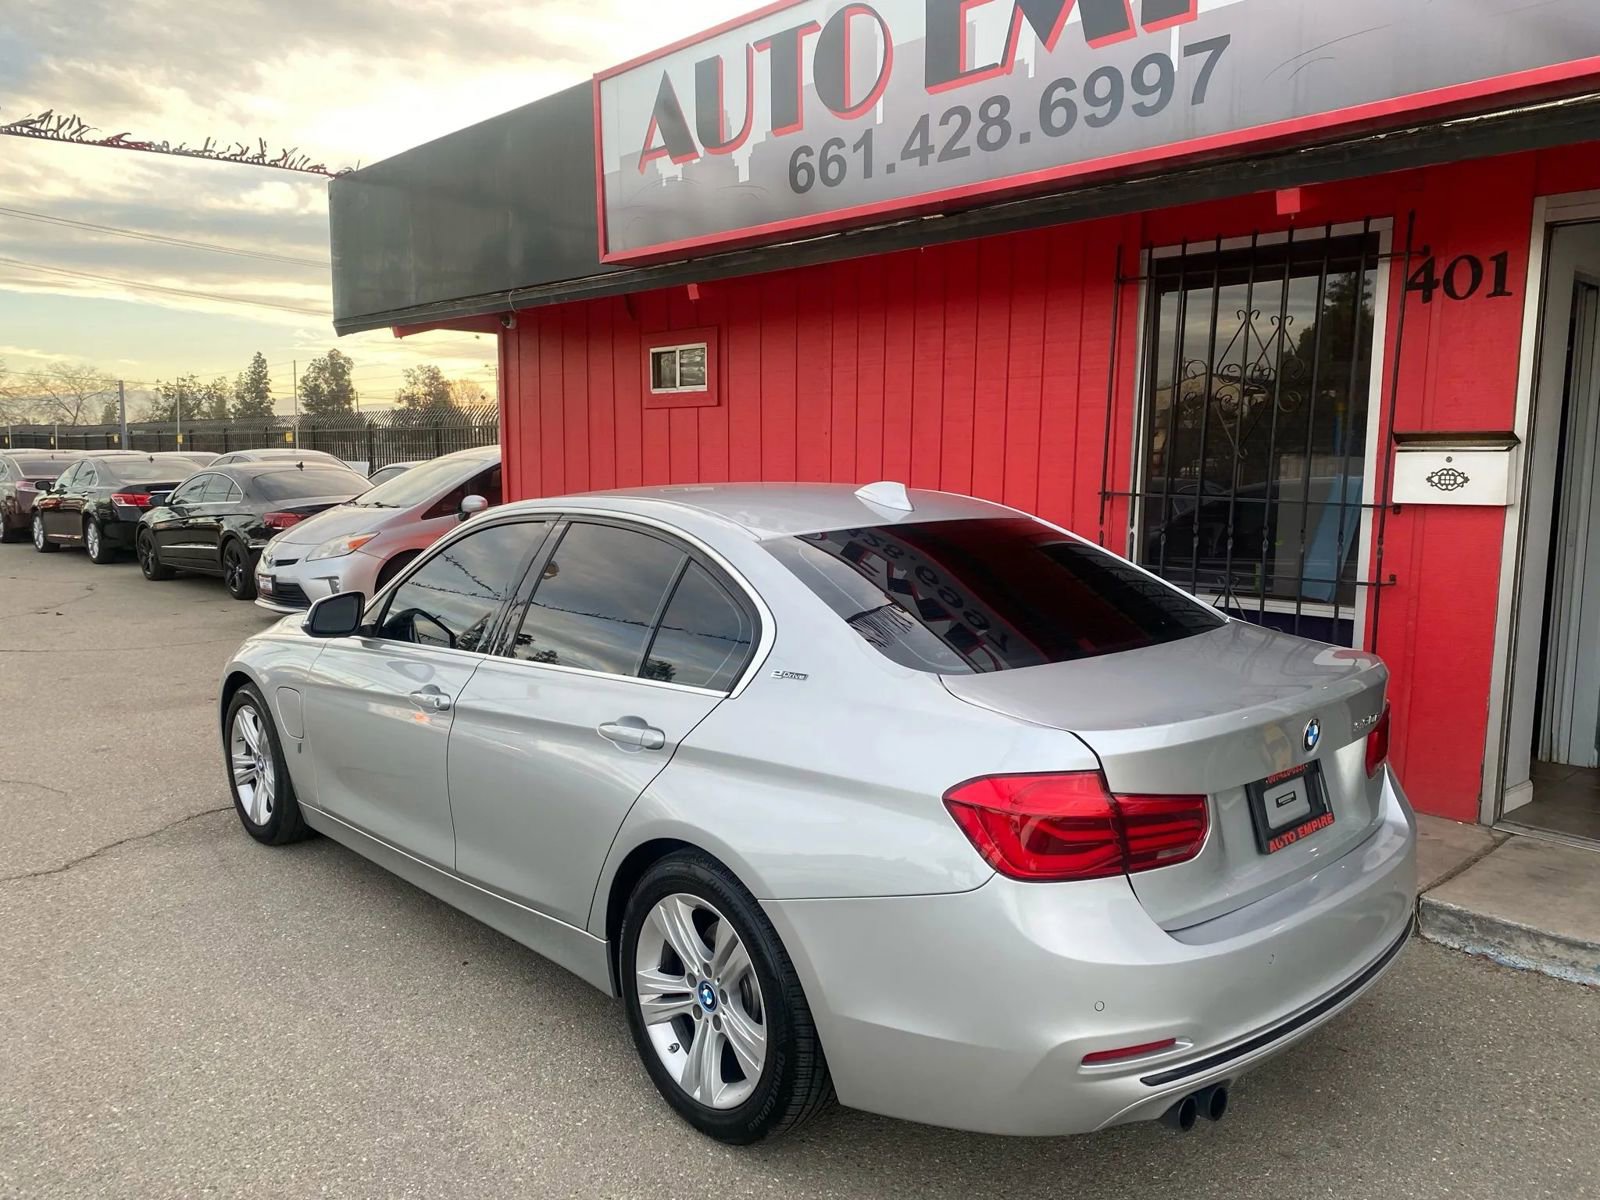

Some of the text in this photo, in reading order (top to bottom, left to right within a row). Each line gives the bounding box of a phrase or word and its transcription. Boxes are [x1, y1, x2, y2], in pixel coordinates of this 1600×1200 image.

[638, 2, 894, 175] AUTO
[788, 34, 1231, 194] 661.428.6997
[1406, 251, 1513, 303] 401
[1267, 812, 1335, 853] AUTO EMPIRE
